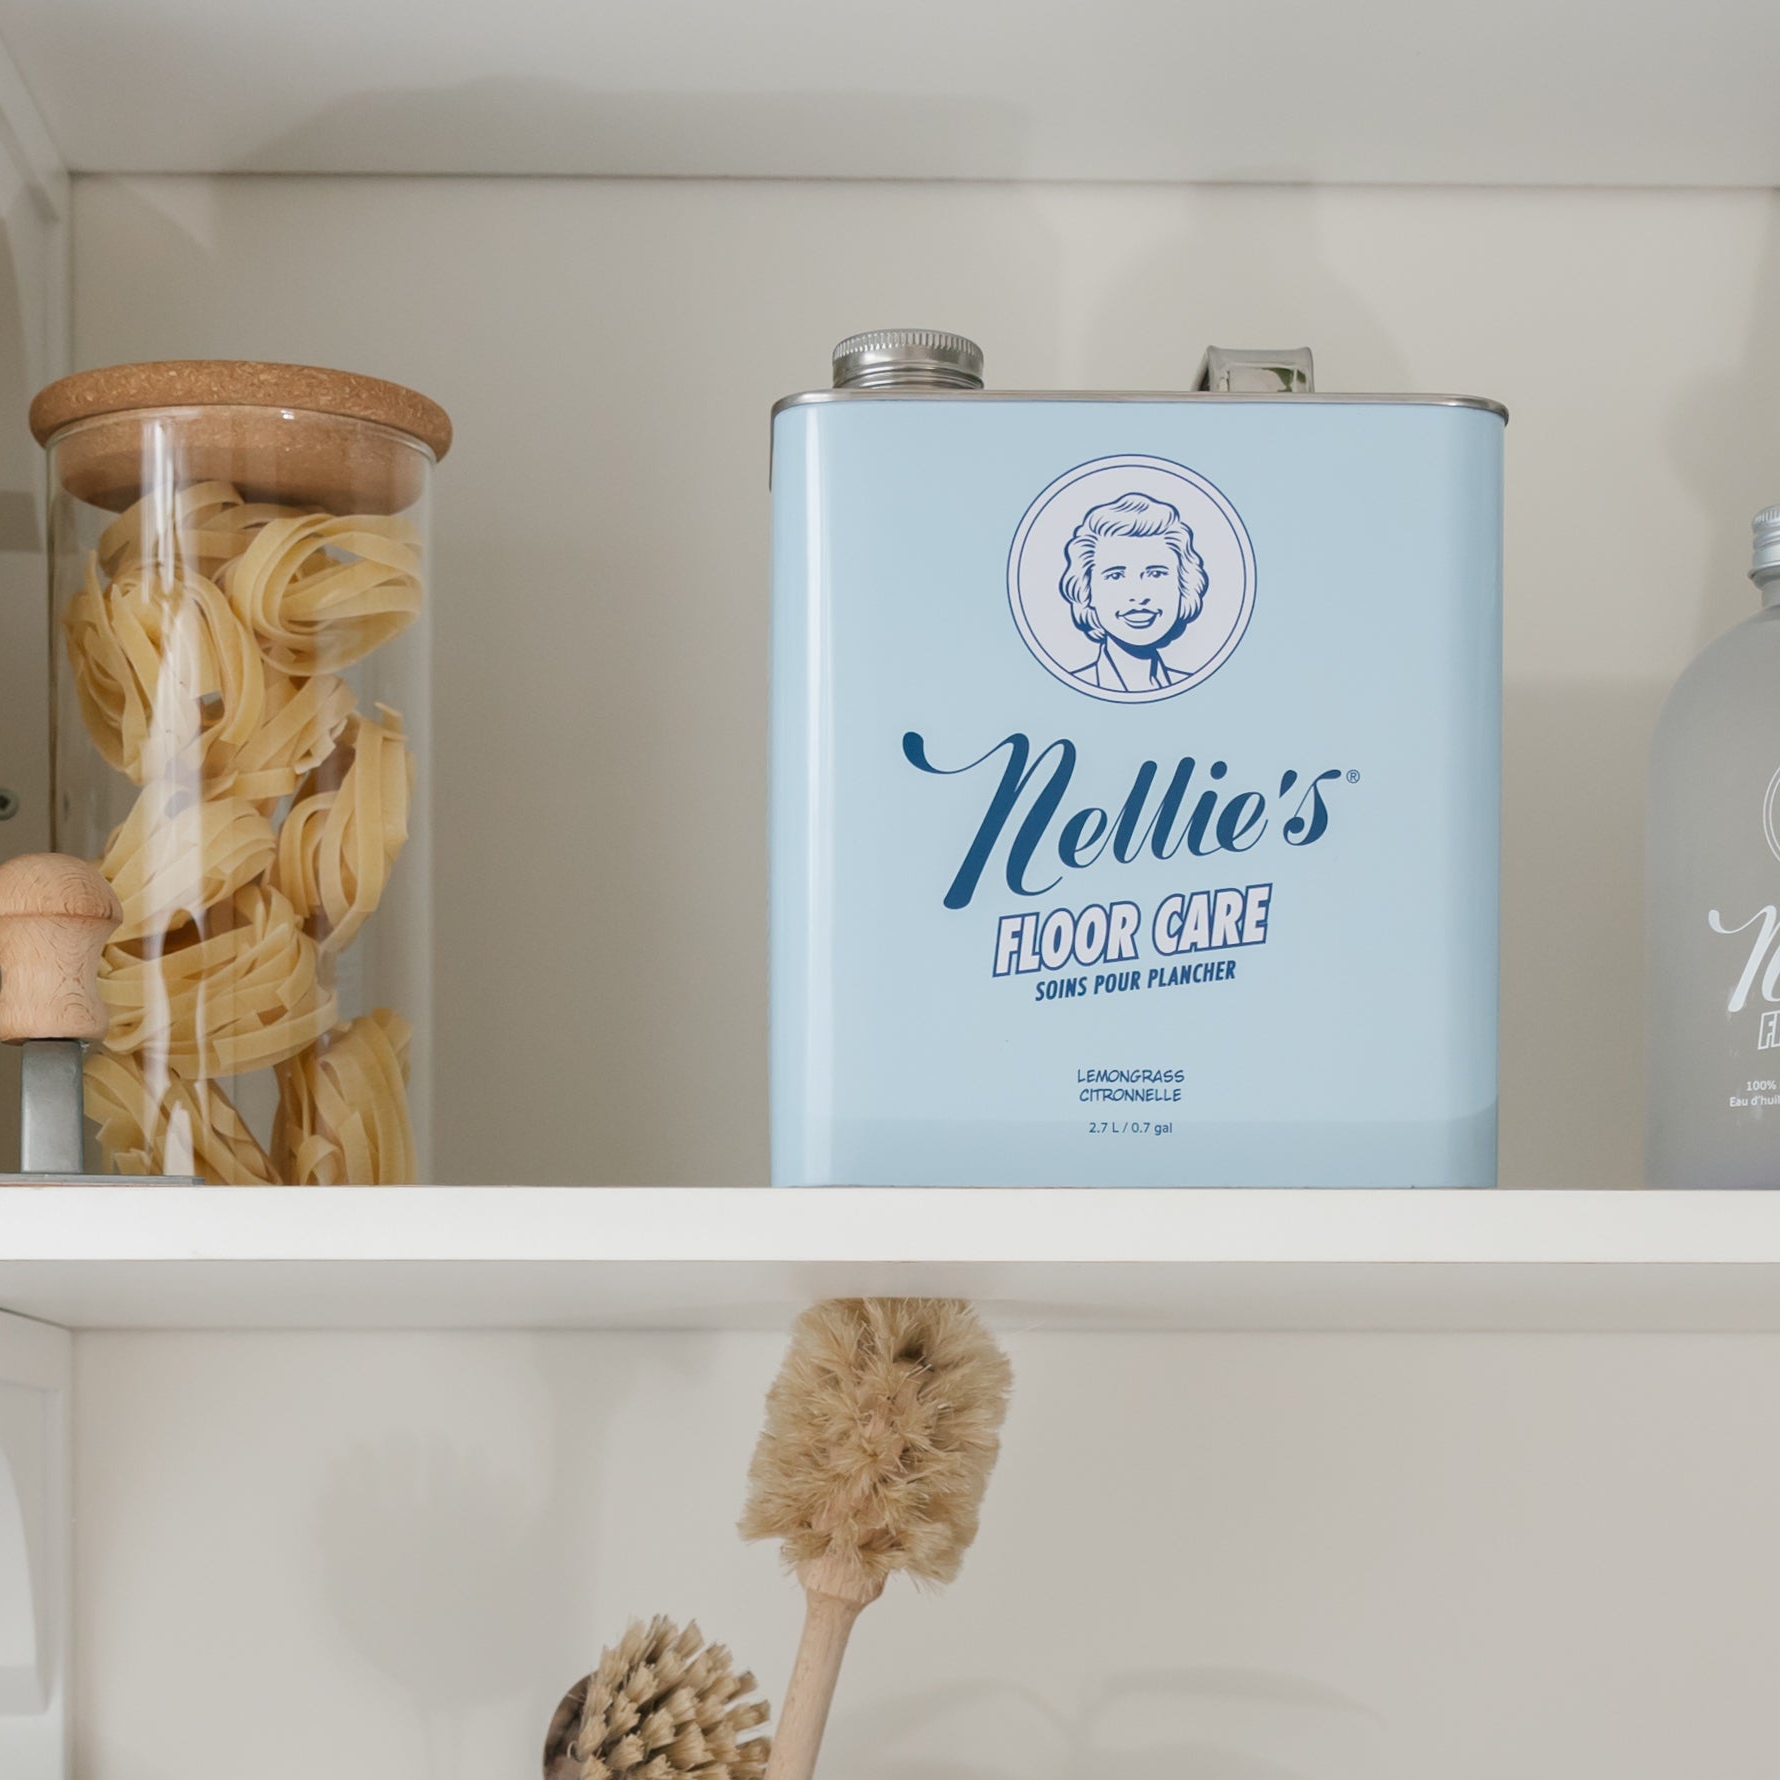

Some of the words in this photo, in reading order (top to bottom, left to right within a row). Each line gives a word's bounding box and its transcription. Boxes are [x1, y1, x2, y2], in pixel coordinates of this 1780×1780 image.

[992, 900, 1142, 978] FLOOR
[1151, 882, 1273, 957] CARE
[1034, 976, 1088, 1002] SOINS
[1093, 970, 1142, 995] POUR
[1146, 960, 1237, 990] PLANCHER
[1076, 1068, 1185, 1084] LEMONGRASS
[1745, 1080, 1777, 1092] 100%
[1078, 1088, 1182, 1102] CITRONNELLE
[1729, 1097, 1749, 1108] Eau
[1088, 1122, 1108, 1134] 2.7
[1112, 1122, 1119, 1134] L
[1131, 1122, 1151, 1134] 0.7
[1154, 1122, 1173, 1137] gal
